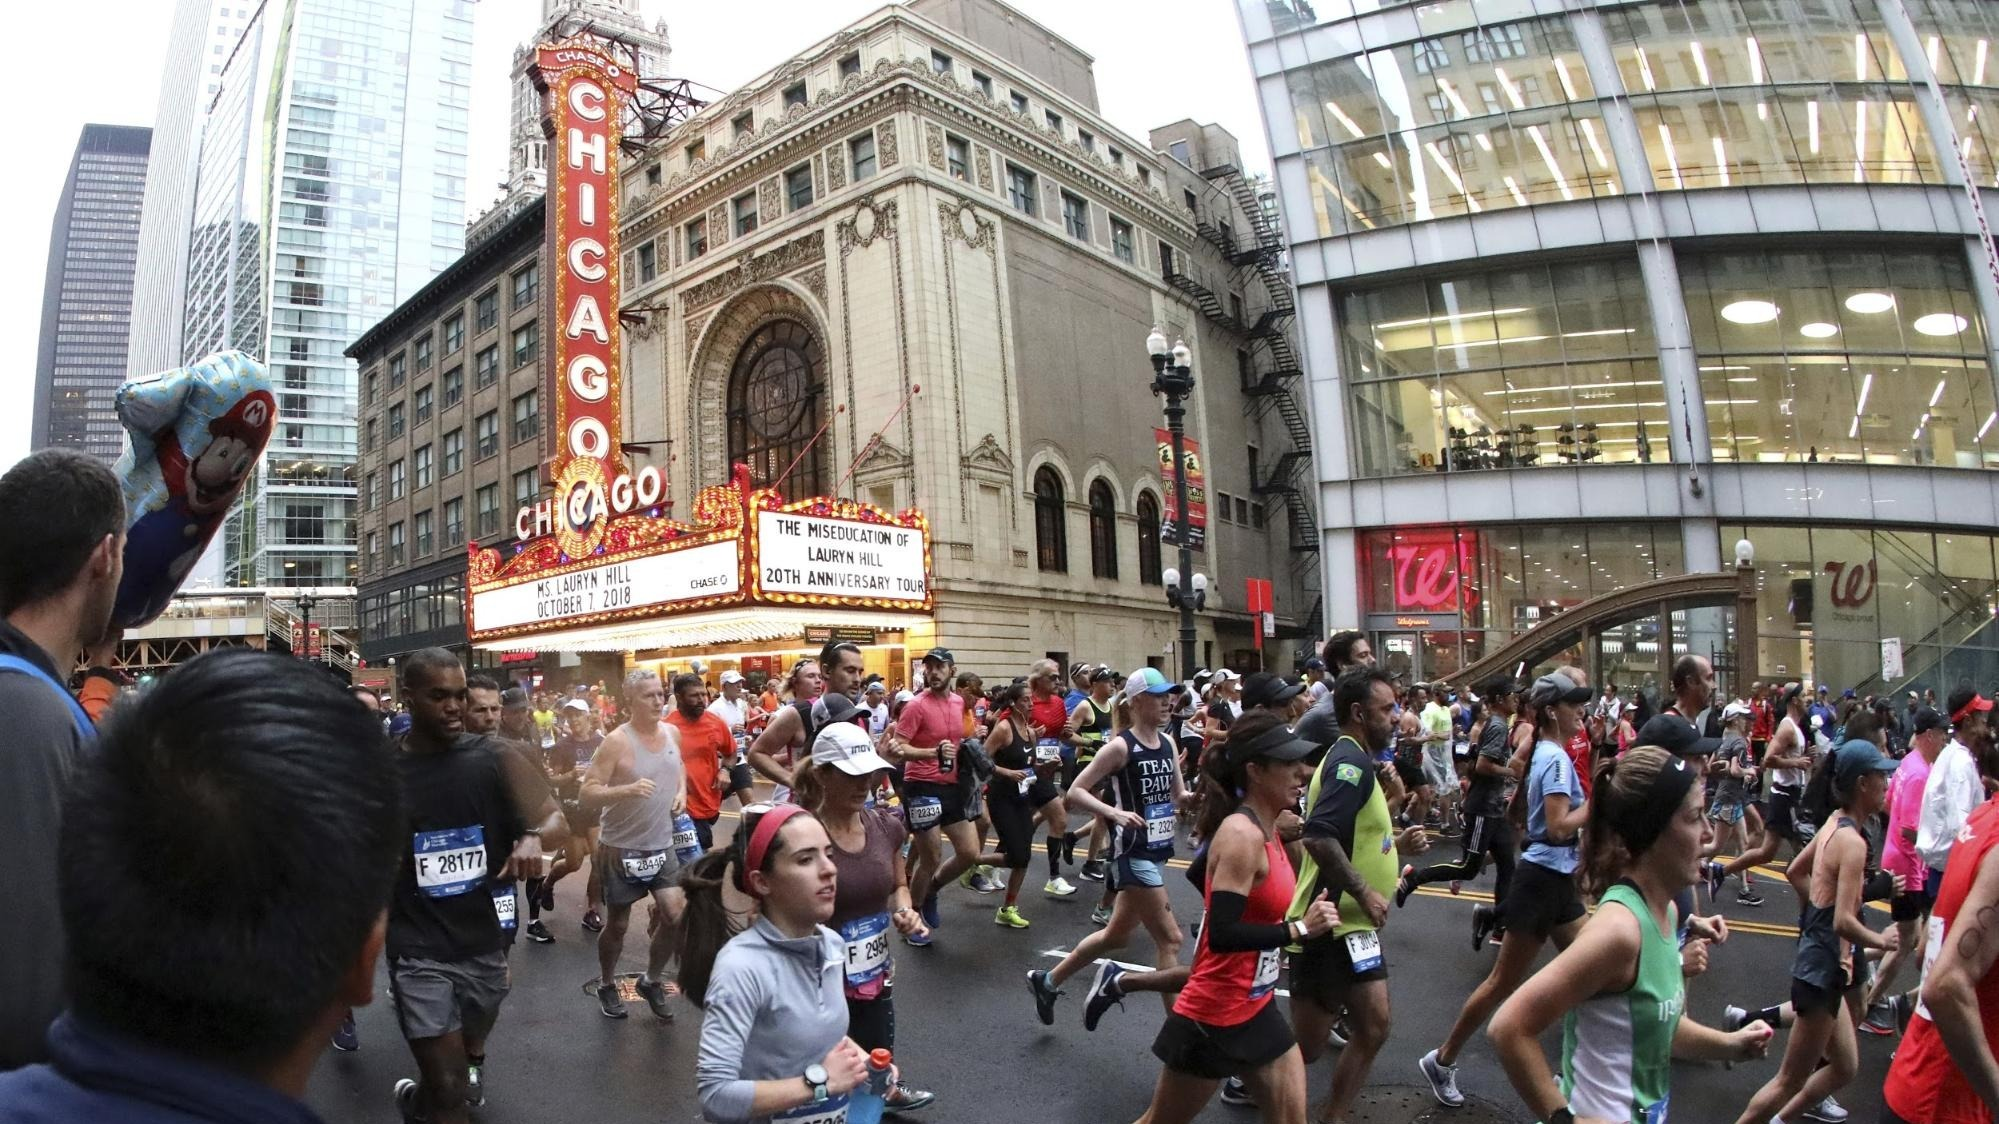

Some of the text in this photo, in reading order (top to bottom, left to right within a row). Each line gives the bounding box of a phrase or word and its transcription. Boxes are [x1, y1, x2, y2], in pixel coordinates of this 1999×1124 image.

[557, 50, 606, 68] CHASE
[566, 82, 609, 464] CHICAGO
[515, 466, 661, 541] CHICAGO
[776, 519, 909, 547] THE MISEDUCATION OF
[808, 546, 883, 568] LAURYN HILL
[537, 565, 631, 598] MS. LAURYN HILL
[690, 576, 718, 589] CHASE
[766, 567, 925, 594] 20TH ANNIVERSARY TOUR
[537, 594, 582, 618] OCTOBER
[603, 586, 631, 608] 2018
[1140, 774, 1173, 795] PAW
[1149, 822, 1155, 836] F
[420, 850, 483, 877] F 28177
[625, 861, 632, 873] F
[848, 945, 857, 965] F
